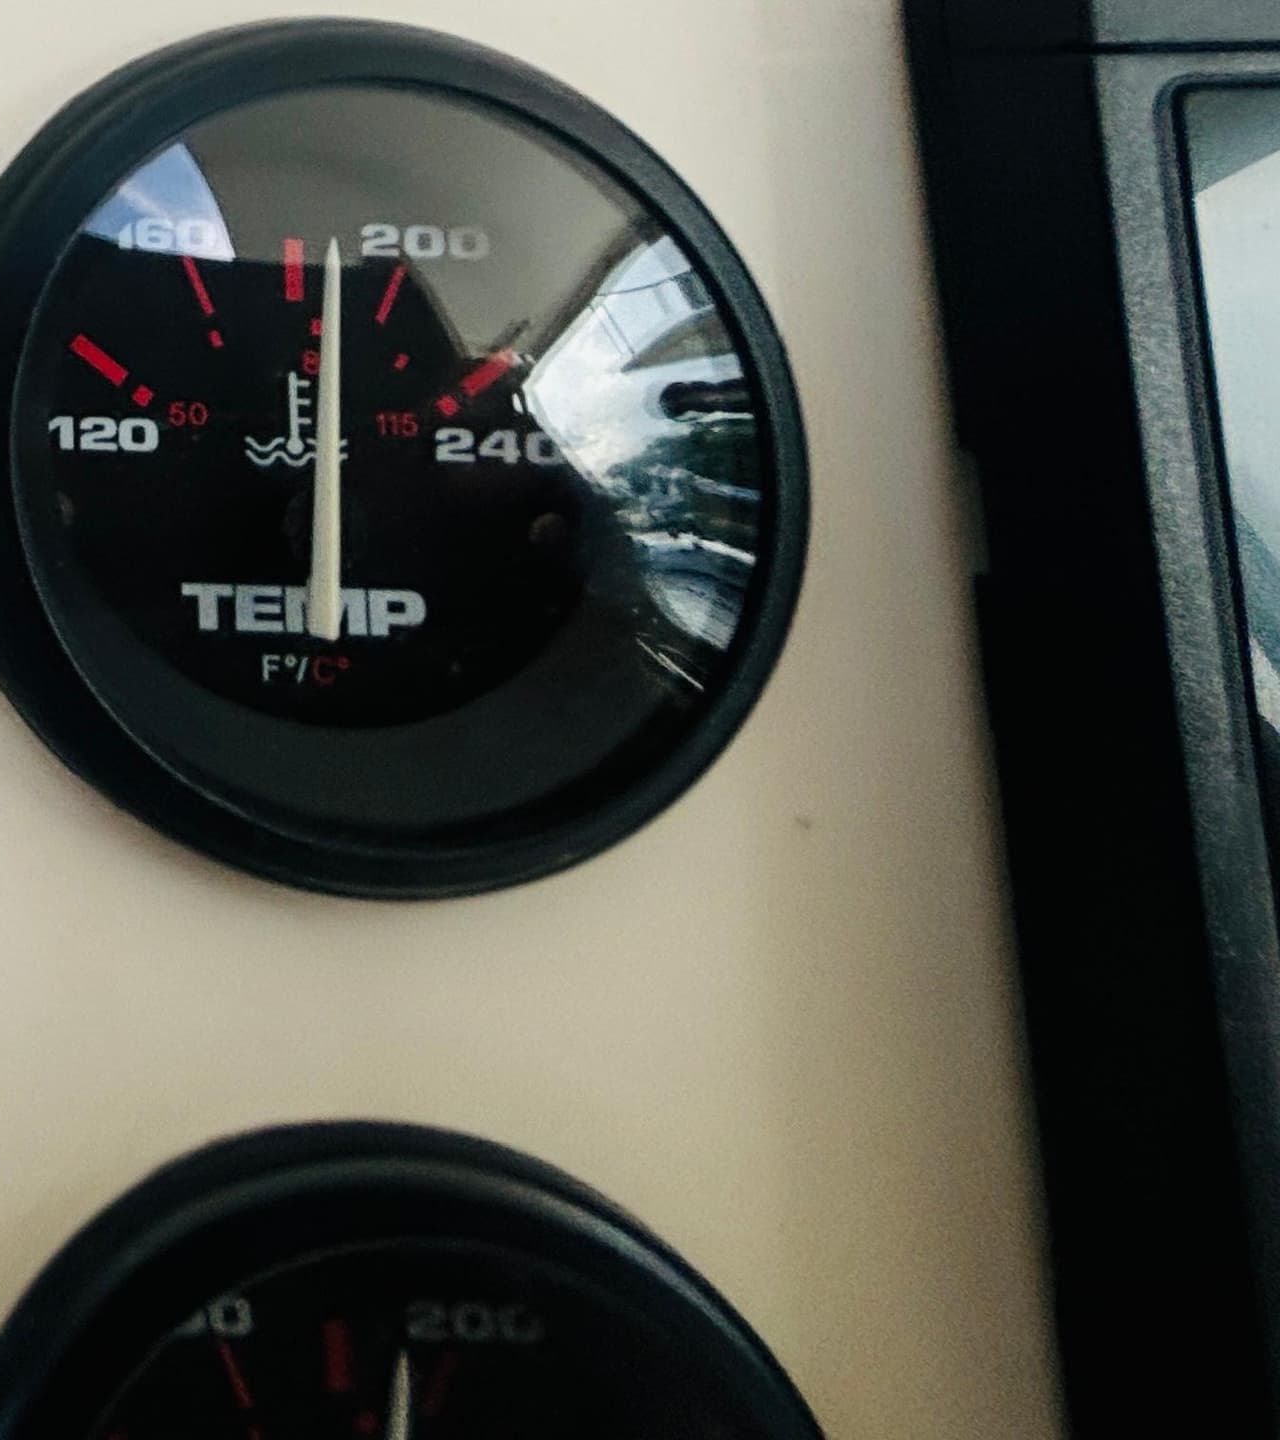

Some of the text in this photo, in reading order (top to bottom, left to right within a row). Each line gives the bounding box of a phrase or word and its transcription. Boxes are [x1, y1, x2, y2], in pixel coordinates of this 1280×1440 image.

[118, 216, 217, 253] 160
[360, 223, 491, 260] 200
[167, 401, 209, 427] 50
[374, 412, 418, 438] 115
[47, 415, 160, 453] 120
[434, 426, 564, 465] 240
[405, 1298, 545, 1343] 200
